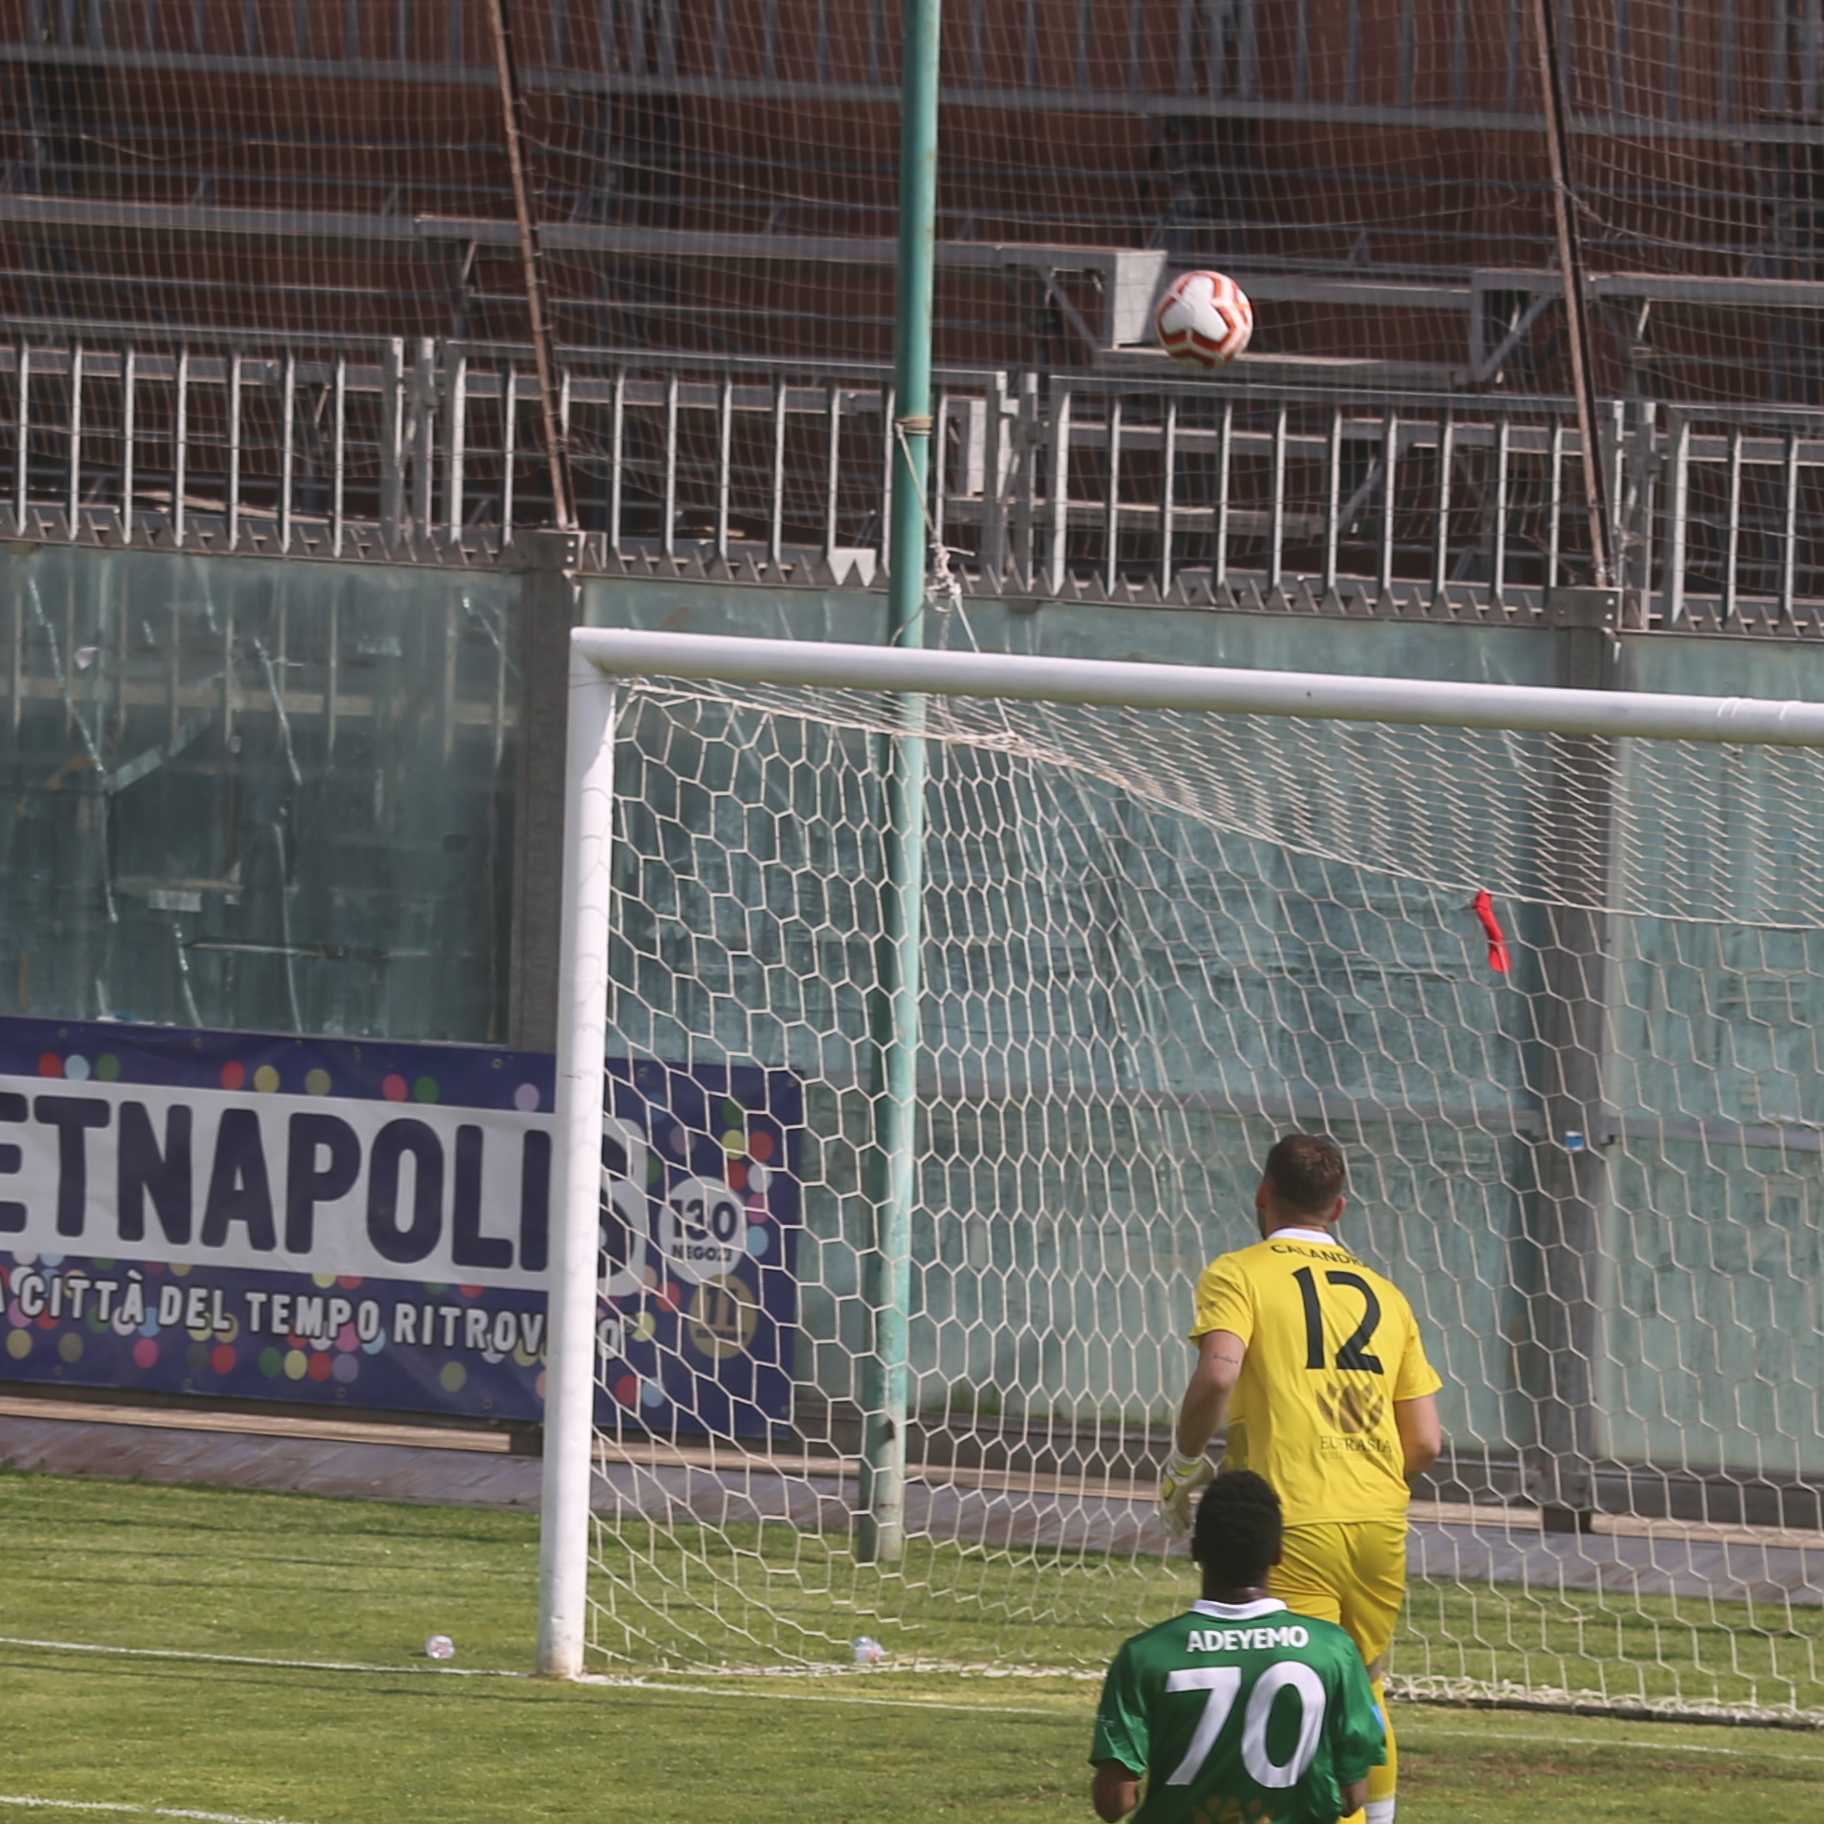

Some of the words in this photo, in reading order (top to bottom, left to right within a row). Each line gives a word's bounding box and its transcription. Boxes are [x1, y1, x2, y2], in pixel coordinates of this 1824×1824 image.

[20, 1269, 145, 1323] CITTÀ
[159, 1285, 231, 1330] DEL
[246, 1292, 380, 1341] TEMPO
[394, 1304, 622, 1360] RITROVO
[1292, 1266, 1384, 1375] 12
[1186, 1626, 1309, 1652] ADEYEMO
[1165, 1661, 1326, 1788] 70
